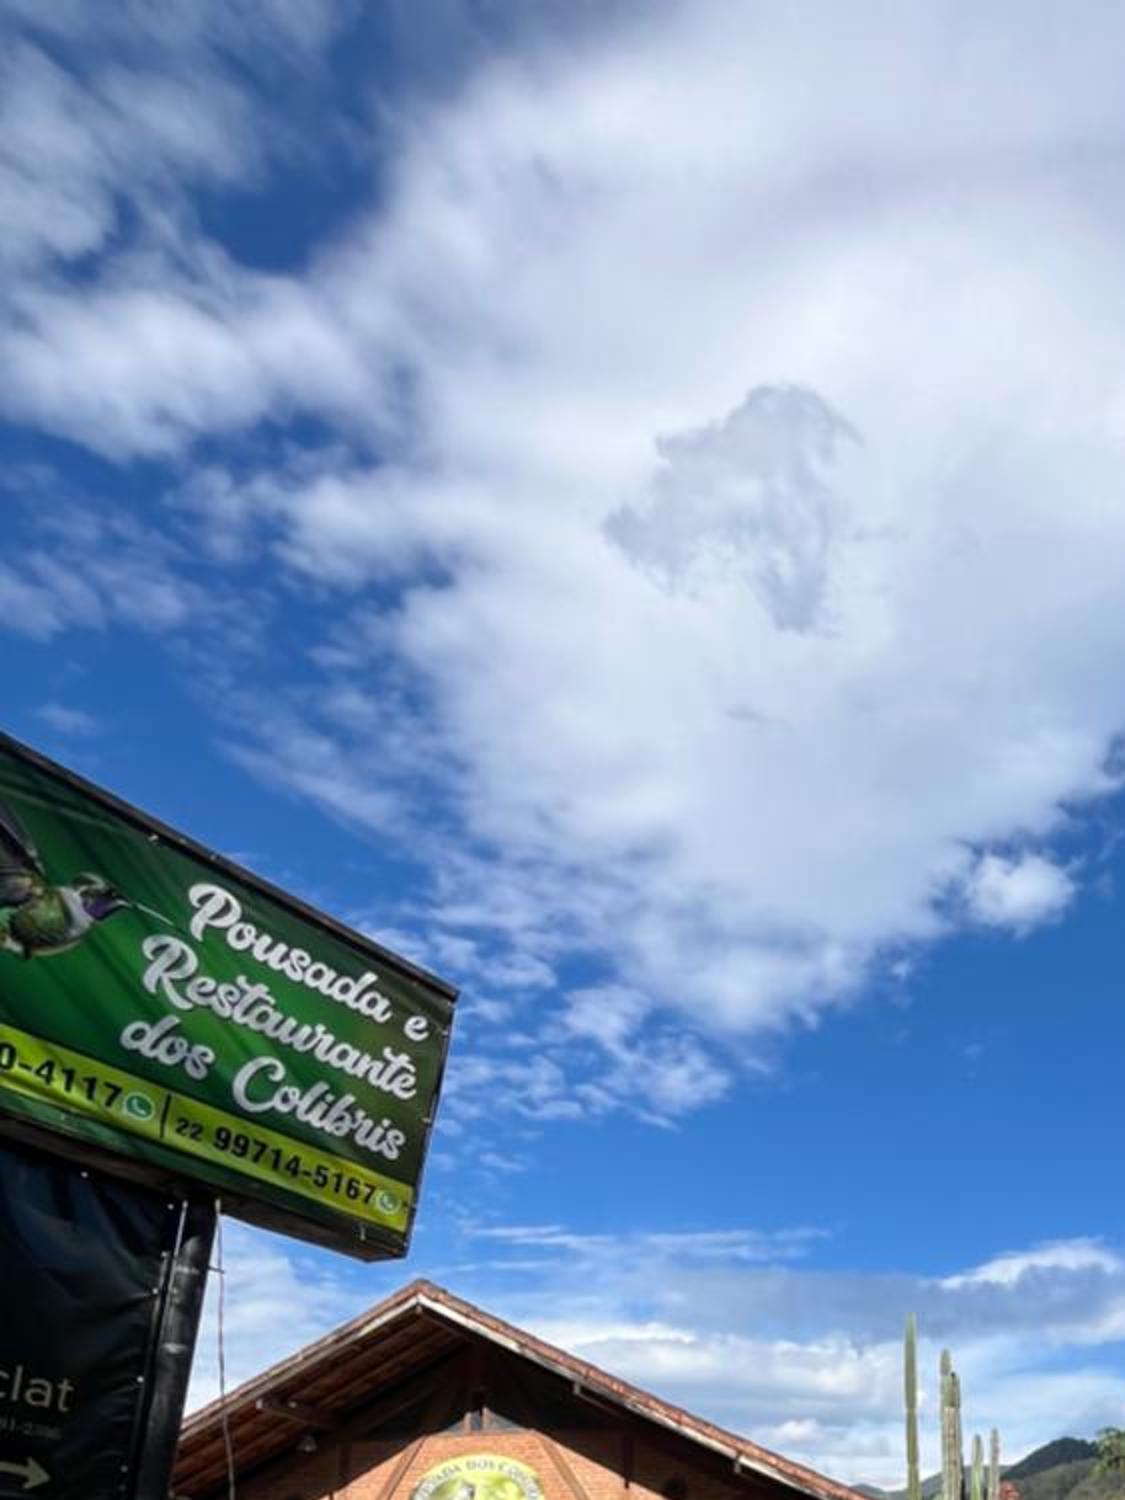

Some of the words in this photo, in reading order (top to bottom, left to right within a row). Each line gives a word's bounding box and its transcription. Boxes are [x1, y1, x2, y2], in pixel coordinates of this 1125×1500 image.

[141, 934, 417, 1100] Restaurante
[188, 883, 393, 1023] Pousada
[404, 1015, 430, 1041] e
[120, 1015, 215, 1080] dos
[232, 1055, 405, 1160] Colibris
[175, 1117, 204, 1142] 22
[214, 1126, 377, 1204] 99714-5167
